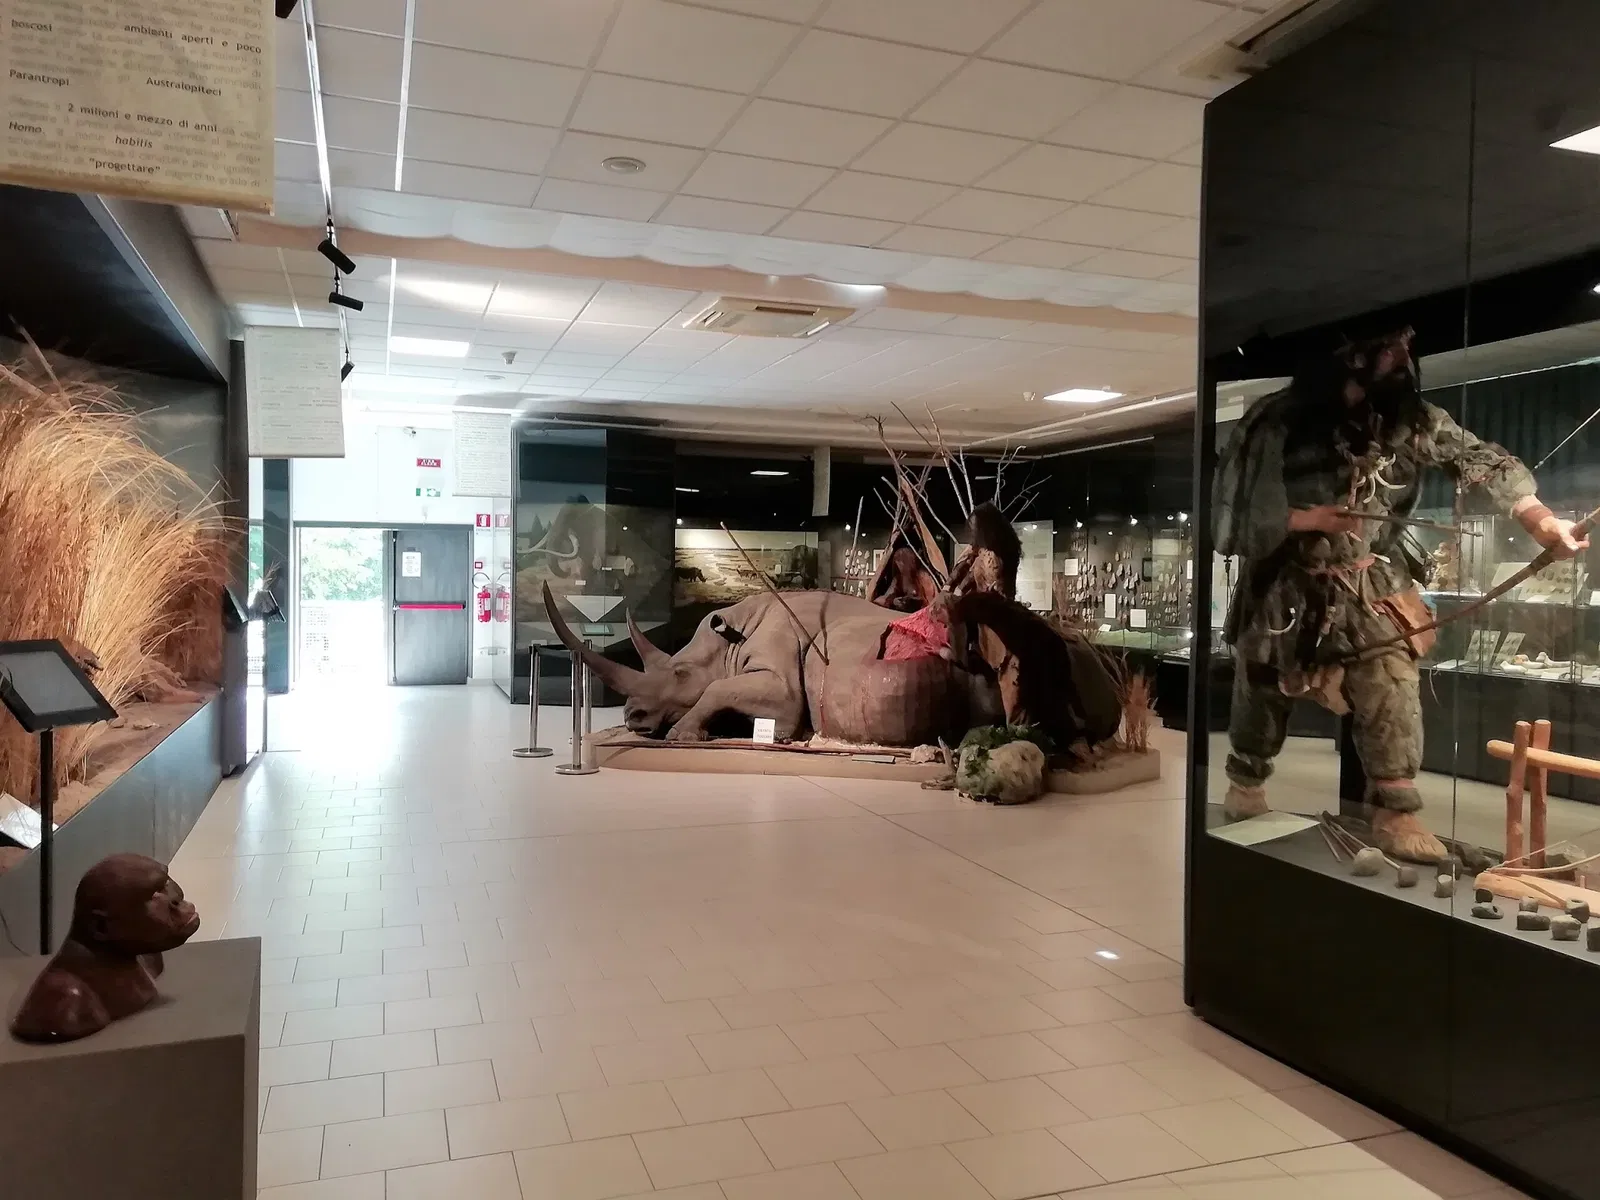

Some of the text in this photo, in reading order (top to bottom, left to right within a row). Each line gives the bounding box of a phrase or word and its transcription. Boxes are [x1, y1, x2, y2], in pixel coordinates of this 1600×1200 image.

[12, 19, 53, 32] boscosi
[124, 24, 173, 39] ambienti
[181, 33, 214, 45] aperti
[236, 42, 262, 54] poco
[9, 68, 70, 87] Parantropi
[146, 77, 222, 97] Australopiteci
[68, 103, 74, 113] 2
[80, 105, 119, 119] milioni
[137, 114, 173, 127] mezzo
[178, 119, 189, 129] di
[194, 122, 218, 133] anni
[115, 135, 153, 149] habilis
